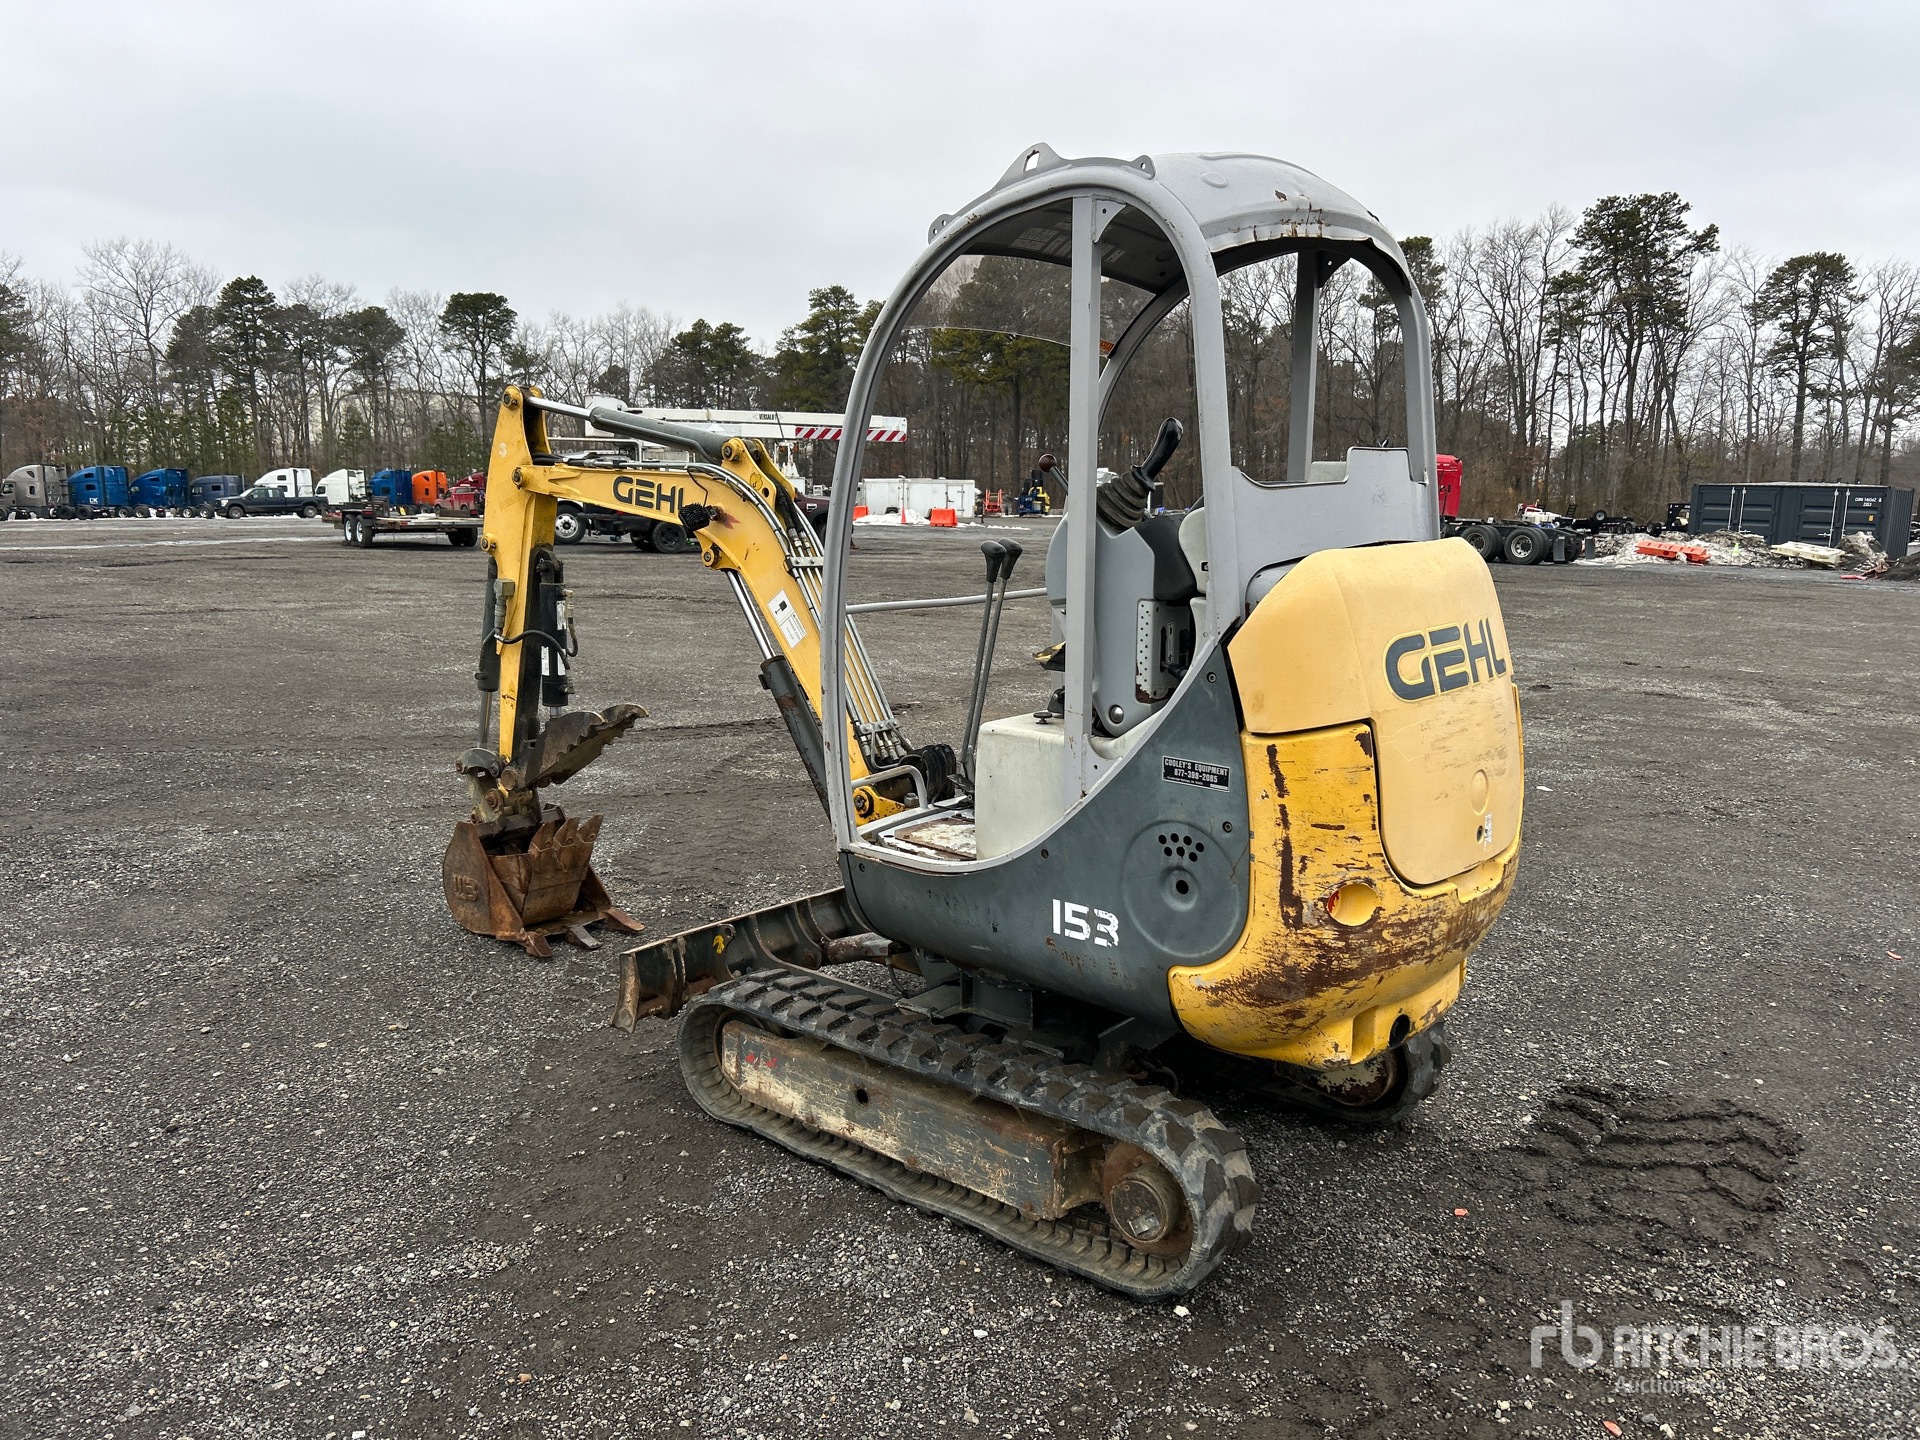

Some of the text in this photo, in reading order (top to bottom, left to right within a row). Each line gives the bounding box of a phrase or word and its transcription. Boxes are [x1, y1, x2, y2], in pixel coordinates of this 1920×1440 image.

[612, 475, 686, 514] GEHL
[1385, 617, 1507, 701] GEHL
[1164, 758, 1228, 776] COOLEY'S EQUIPMENT
[1052, 898, 1120, 948] 153
